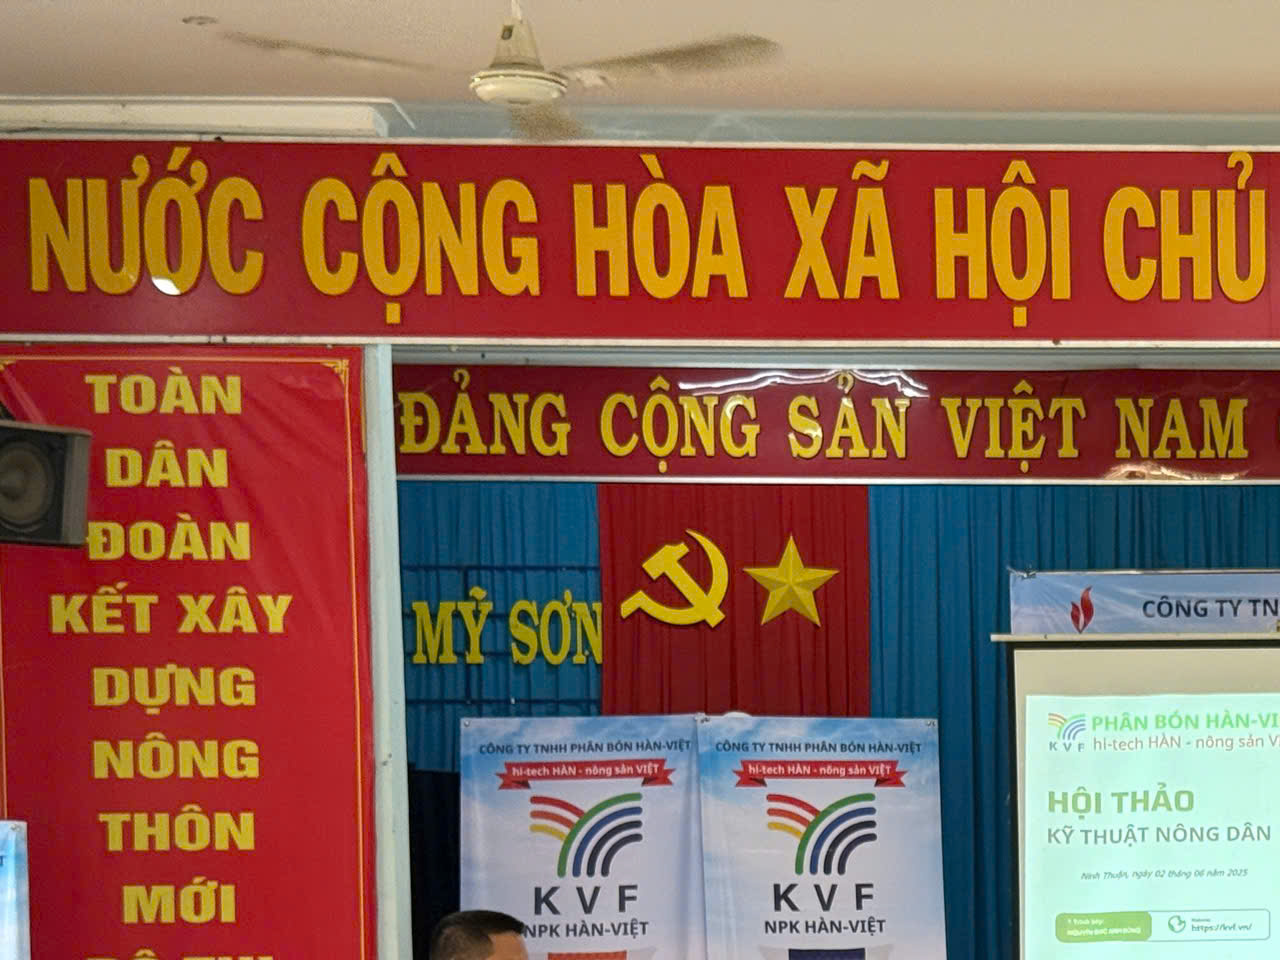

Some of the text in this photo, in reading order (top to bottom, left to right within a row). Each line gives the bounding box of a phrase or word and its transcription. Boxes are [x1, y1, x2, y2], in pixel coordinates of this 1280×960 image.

[29, 147, 265, 294] NƯỚC
[301, 152, 540, 324] CỘNG
[573, 153, 748, 299] HÒA
[783, 159, 900, 299] XÃ
[934, 160, 1071, 327] HỘI
[1103, 148, 1267, 302] CHỦ
[85, 366, 242, 415] TOÀN
[398, 369, 571, 456] ĐẢNG
[600, 375, 761, 473] CỘNG
[787, 373, 909, 459] SẢN
[940, 379, 1086, 473] VIỆT
[1115, 398, 1249, 459] NAM
[105, 440, 229, 488] DÂN
[86, 513, 251, 561] ĐOÀN
[50, 582, 293, 634] KẾT XÂY
[411, 586, 603, 665] MỸ SƠN
[1142, 595, 1208, 619] CÔNG
[1214, 600, 1241, 618] TY
[92, 663, 256, 715] DỰNG
[1092, 711, 1148, 731] PHÂN
[1155, 710, 1199, 730] BÓN
[1093, 737, 1143, 751] hi-tech
[1149, 733, 1181, 749] HÀN
[1196, 736, 1234, 751] nông
[1238, 733, 1264, 748] sản
[93, 732, 260, 780] NÔNG
[480, 738, 691, 755] CÔNG TY TNHH PHÂN BÓN HÀN-VIỆT
[716, 740, 922, 756] CÔNG TY TNHH PHÂN BÓN HÀN-VIỆT
[512, 762, 659, 777] hi-tech HÀN nông sản VIỆT
[749, 763, 891, 777] hi-tech HÀN nông sản VIỆT
[1048, 782, 1194, 820] HỘI THẢO
[98, 804, 255, 852] THÔN
[1047, 822, 1271, 847] KỸ THUẬT NÔNG DÂN
[122, 876, 236, 924] MỚI
[524, 920, 649, 939] NPK HÀN-VIỆT
[764, 916, 886, 936] NPK HÀN-VIỆT
